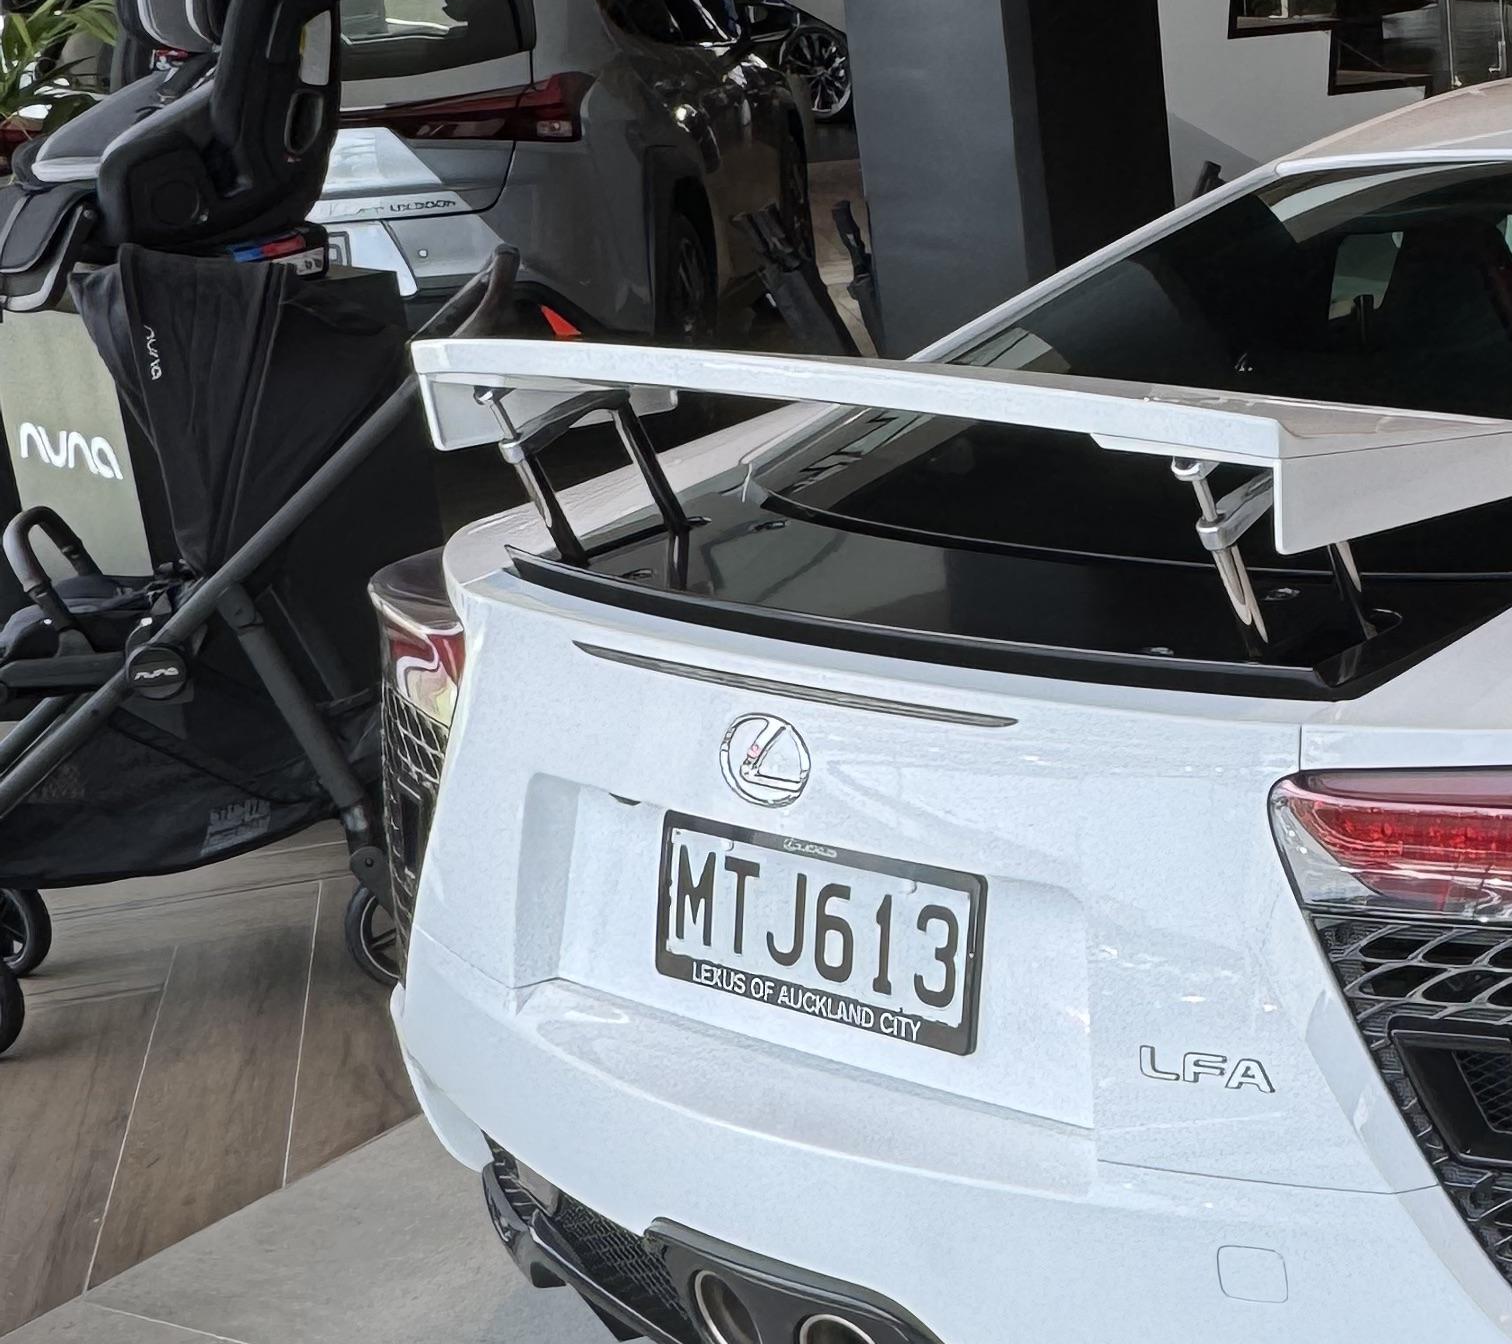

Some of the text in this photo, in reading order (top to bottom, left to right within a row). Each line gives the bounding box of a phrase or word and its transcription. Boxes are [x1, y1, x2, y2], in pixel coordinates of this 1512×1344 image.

[20, 421, 124, 481] nuna
[675, 843, 960, 1008] MTJ613
[692, 961, 922, 1042] LEXUS OF AUCKLAND CITY
[1139, 1044, 1276, 1094] LFA
